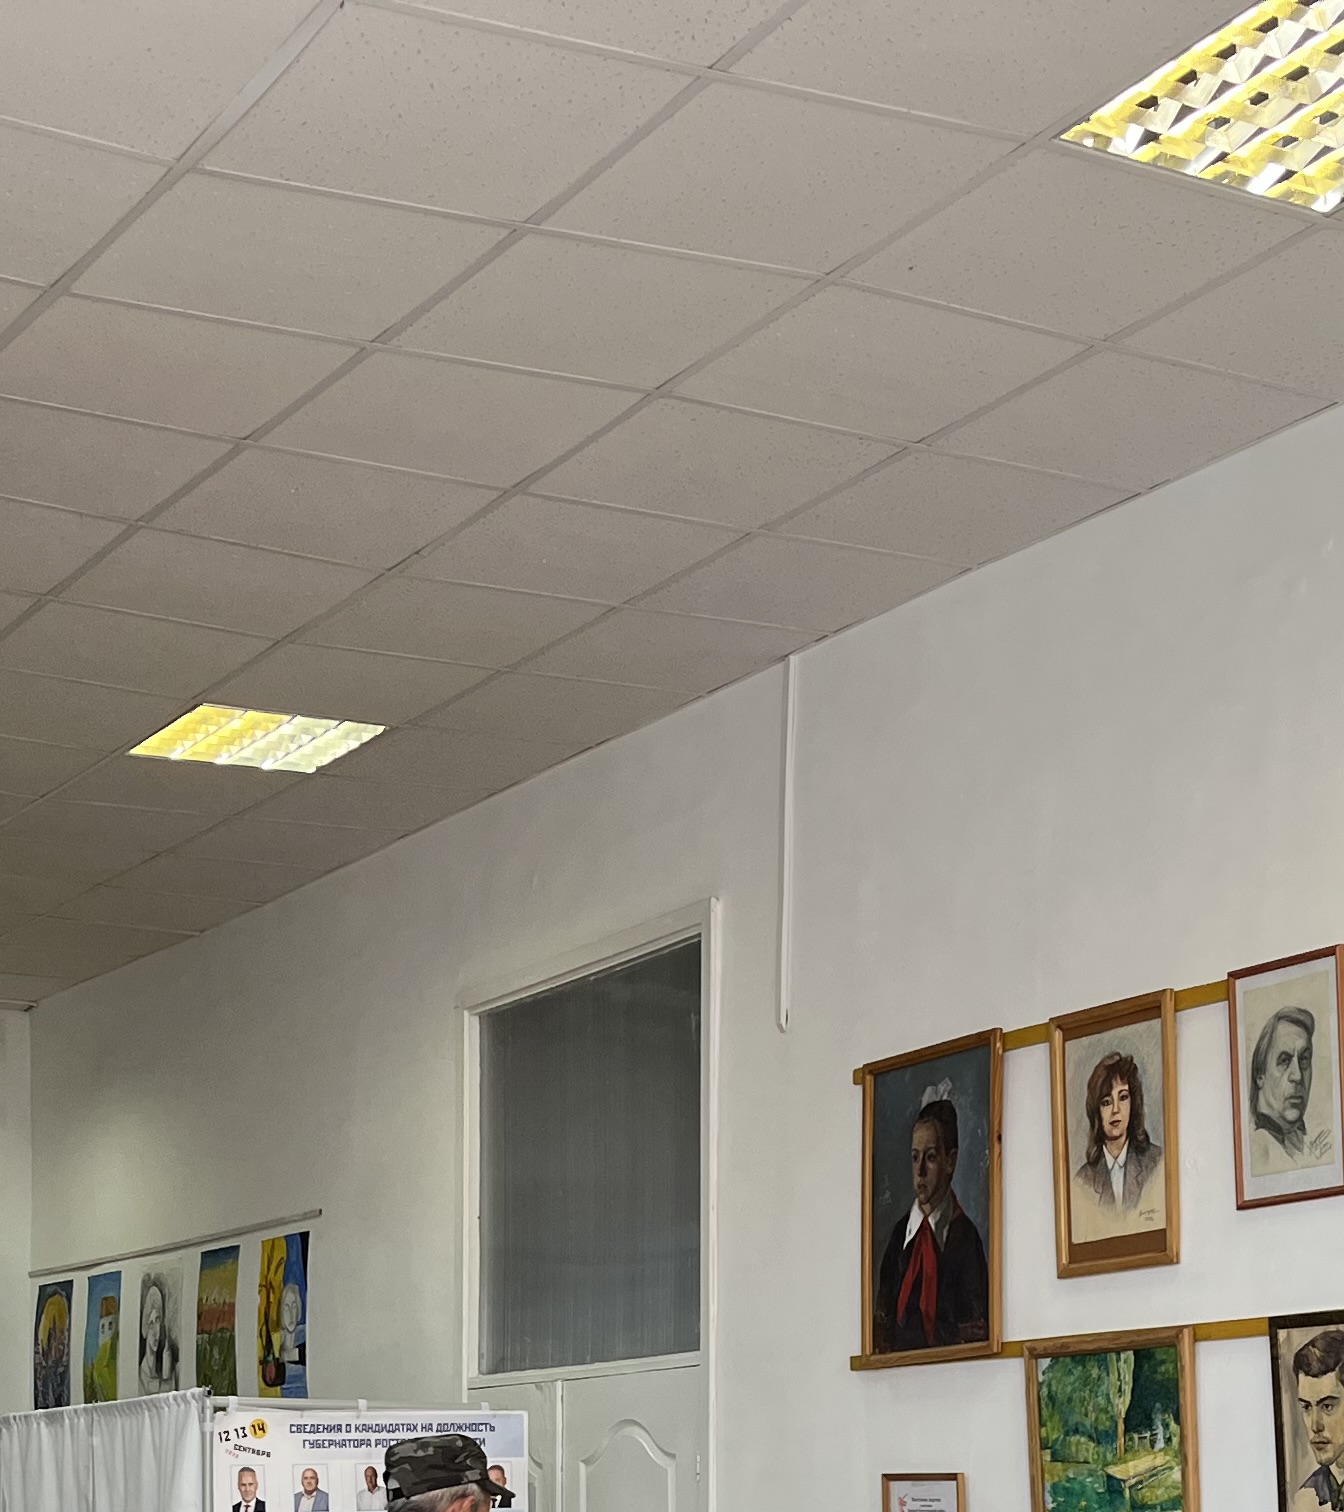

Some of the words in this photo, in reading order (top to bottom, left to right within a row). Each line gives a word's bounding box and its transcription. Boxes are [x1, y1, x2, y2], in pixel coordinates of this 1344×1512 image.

[218, 1430, 231, 1443] 12
[234, 1427, 248, 1439] 13
[250, 1422, 266, 1436] 14
[289, 1423, 342, 1434] СВЕДЕНИЯ
[345, 1424, 351, 1433] О
[355, 1423, 418, 1433] КАНДИДАТАХ
[421, 1423, 433, 1432] НА
[436, 1422, 495, 1433] ДОЛЖНОСТЬ
[303, 1439, 372, 1449] ГУБЕРНАТОРА
